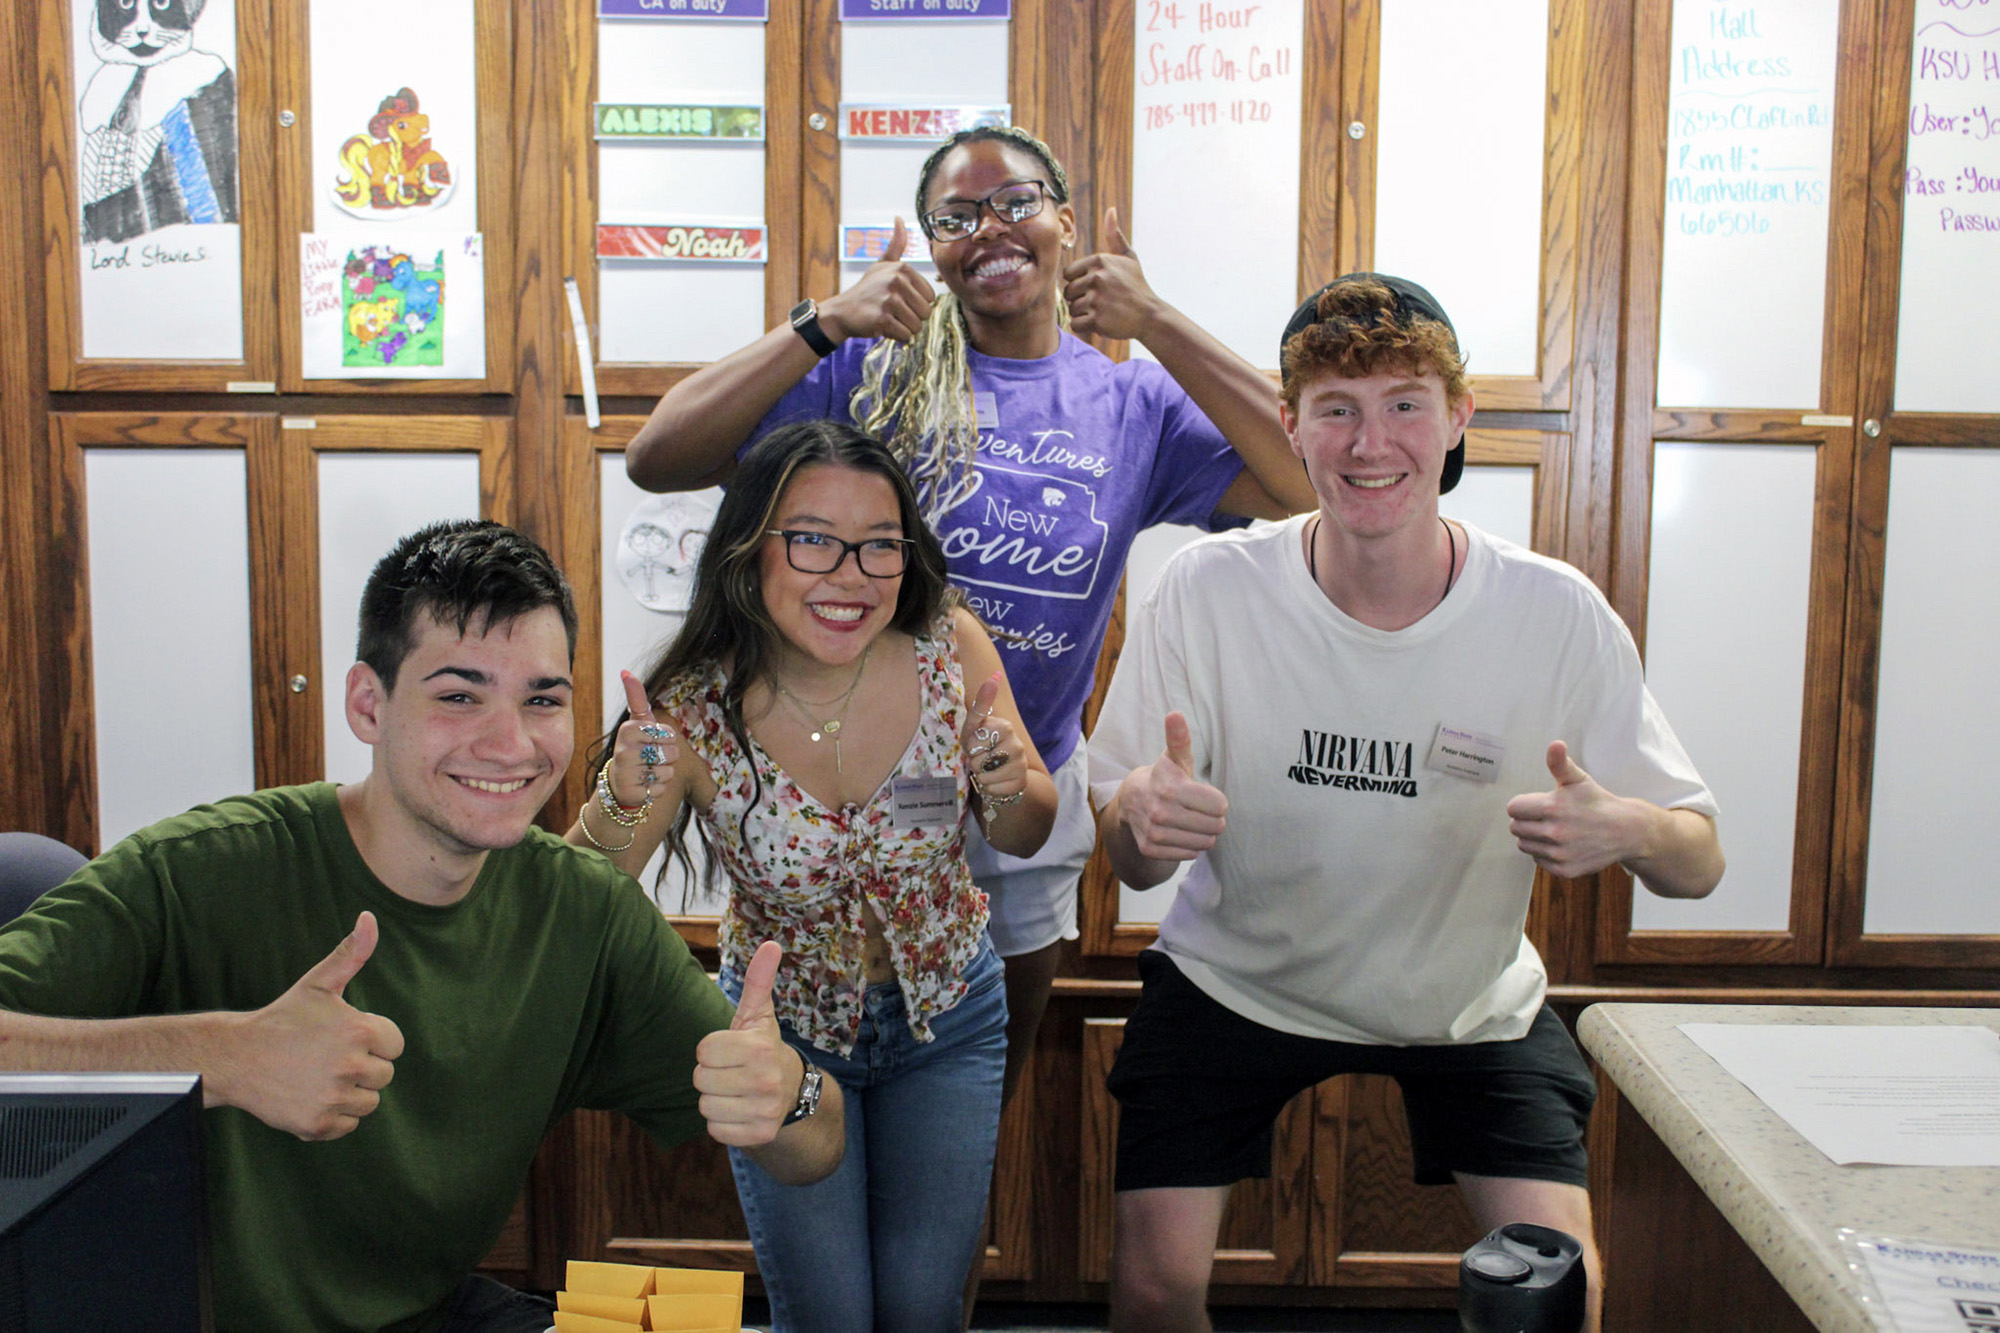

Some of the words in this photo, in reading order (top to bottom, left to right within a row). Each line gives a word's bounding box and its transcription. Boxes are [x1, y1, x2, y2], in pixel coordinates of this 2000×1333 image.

[639, 0, 664, 9] CA
[669, 0, 687, 10] on
[923, 0, 941, 10] on
[1146, 0, 1186, 31] 24
[1200, 2, 1261, 33] Hour
[1710, 7, 1764, 39] Hall
[1141, 42, 1206, 86] Staff
[1682, 45, 1791, 85] Address
[1920, 46, 1970, 81] KSU
[602, 108, 713, 133] ALEXIS
[1795, 180, 1824, 206] KS
[1680, 210, 1770, 238] 66506
[662, 227, 748, 257] Noah
[91, 246, 130, 270] Lord
[982, 495, 1059, 537] New
[1297, 729, 1412, 778] NIRVANA
[1441, 746, 1458, 756] Peter
[1459, 751, 1494, 765] Harrington
[1287, 765, 1418, 798] NEVERMIND
